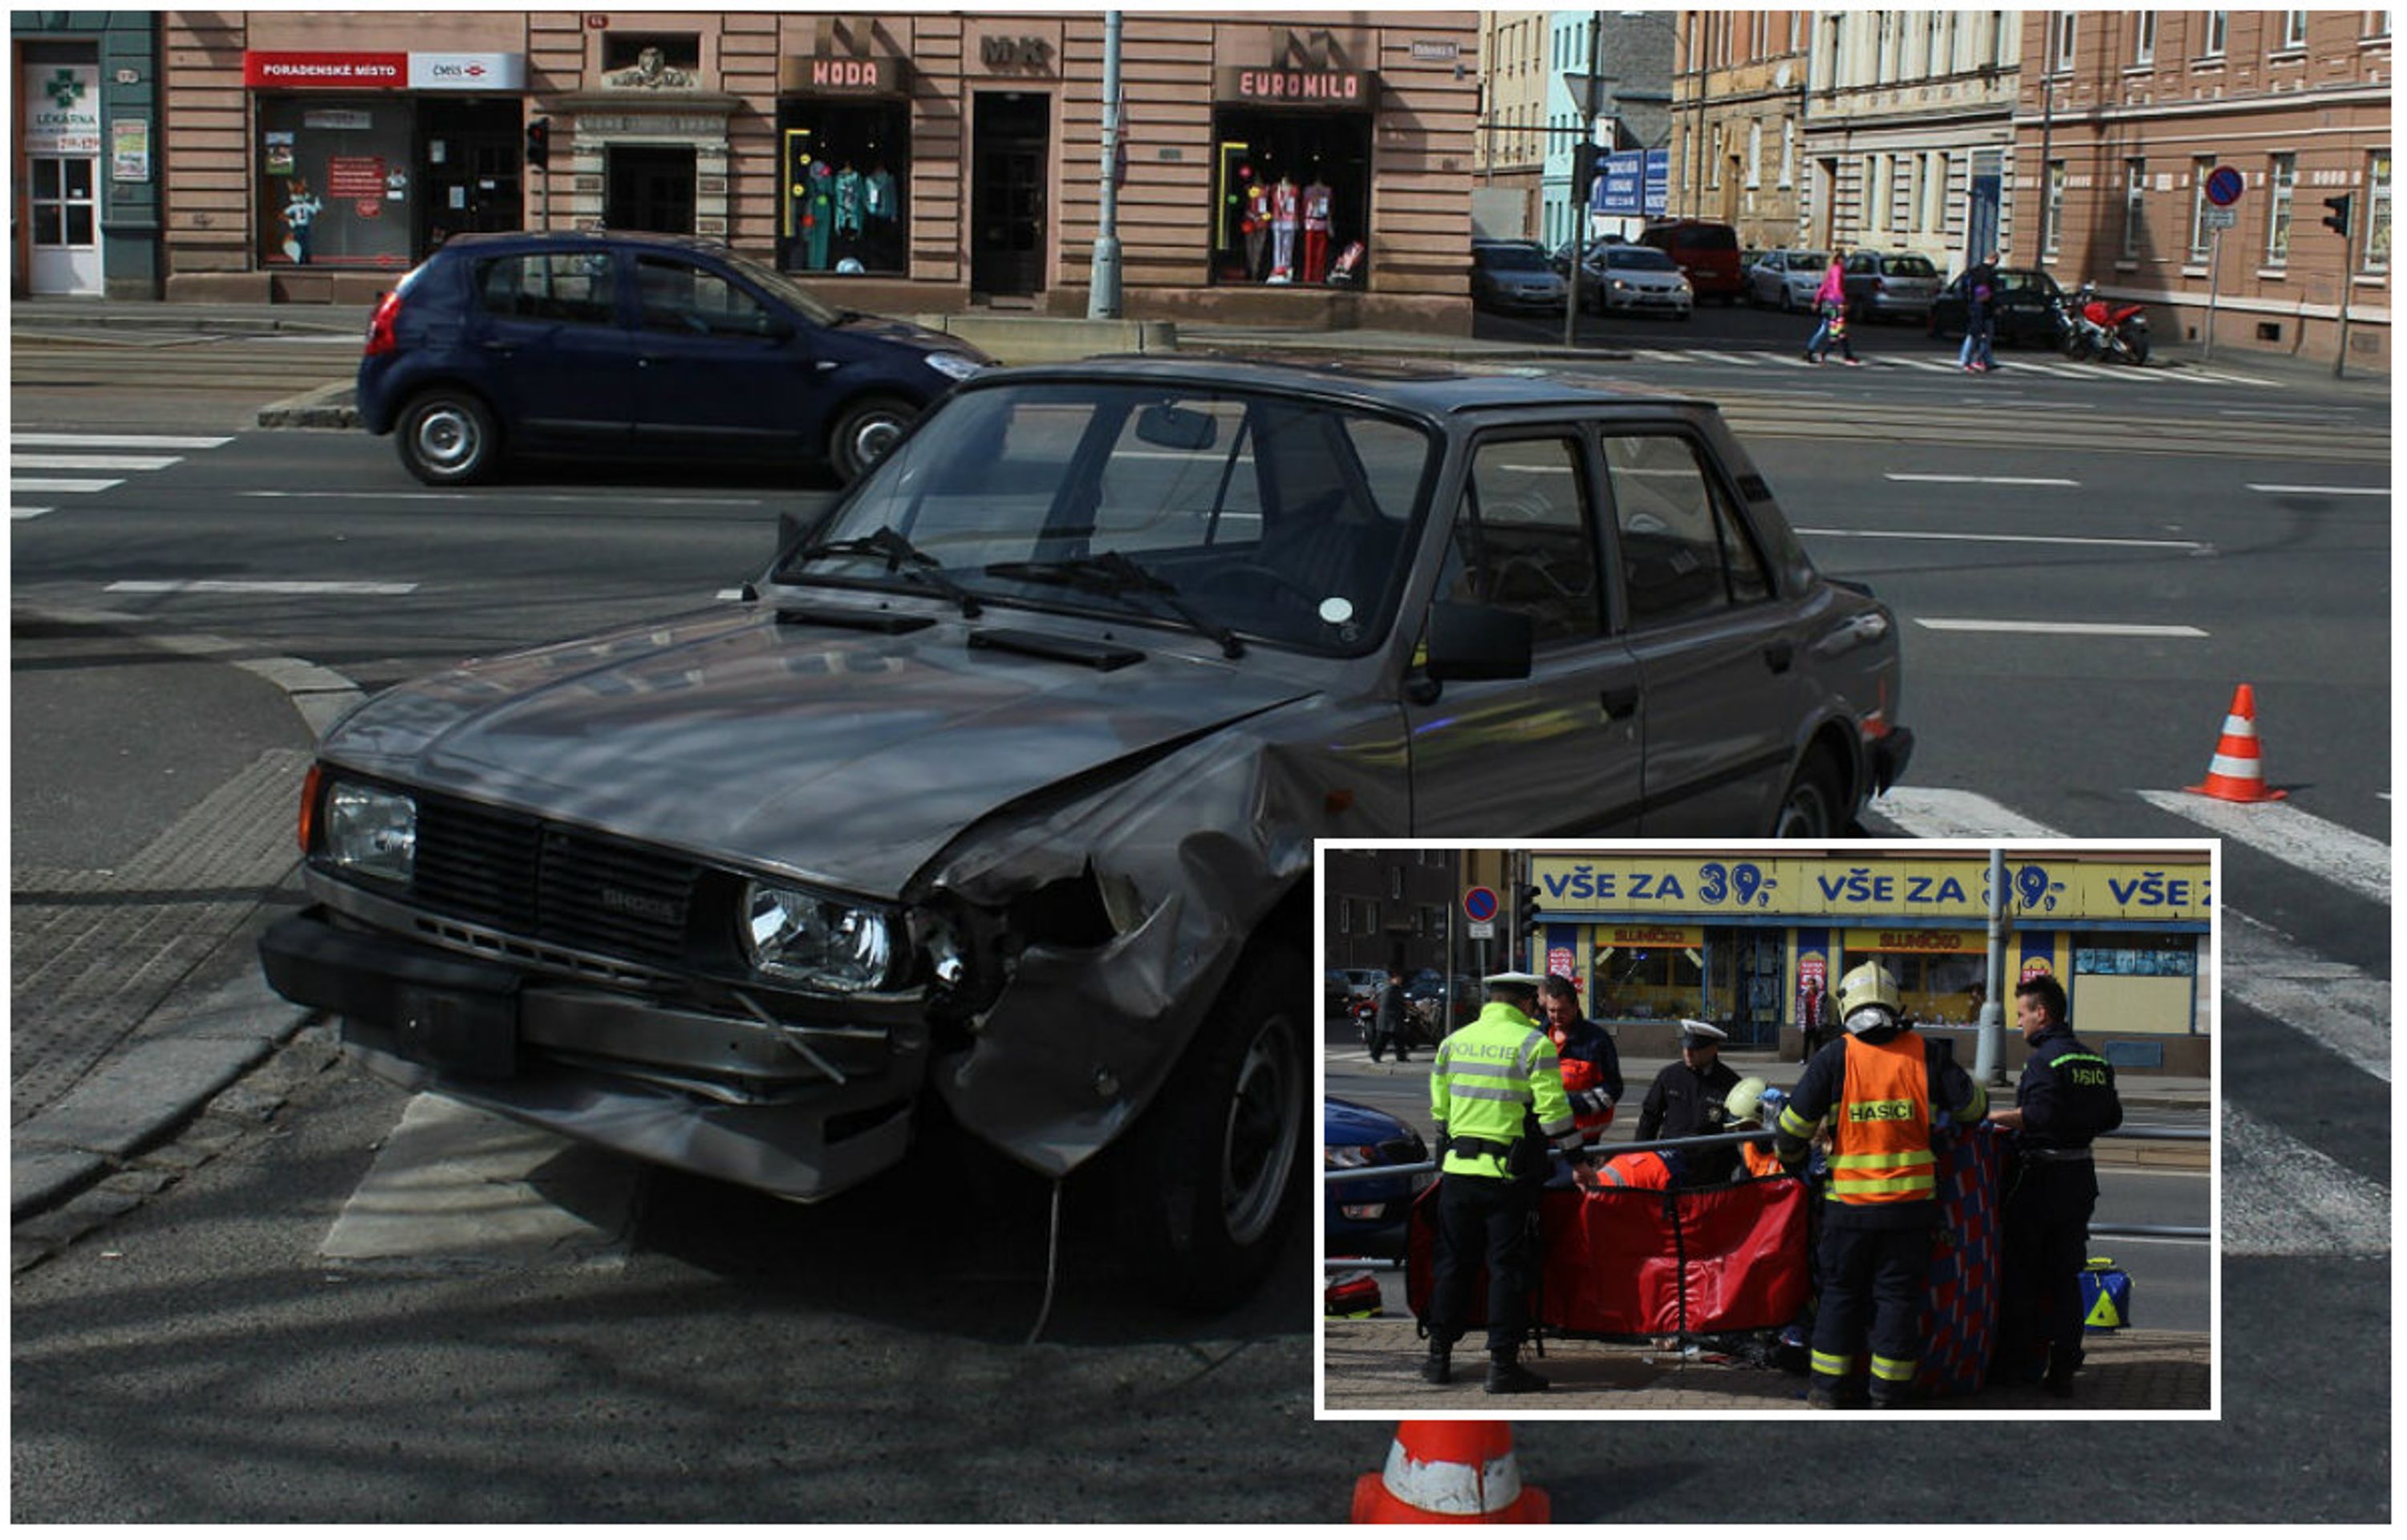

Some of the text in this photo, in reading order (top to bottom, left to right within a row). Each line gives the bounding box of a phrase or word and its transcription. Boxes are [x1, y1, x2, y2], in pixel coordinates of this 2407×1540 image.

[262, 63, 396, 76] PORADENSKÉ MÍSTO
[814, 62, 877, 86] MODA
[1240, 72, 1358, 98] EUROMILO
[36, 112, 95, 124] LÉKÁRNA
[1543, 865, 1617, 899] VŠE
[1626, 873, 1685, 899] ZA
[1816, 868, 1894, 902] VŠE
[1906, 877, 1967, 903] ZA
[2107, 871, 2190, 906] VŠE
[1850, 1101, 1914, 1121] HASIČI
